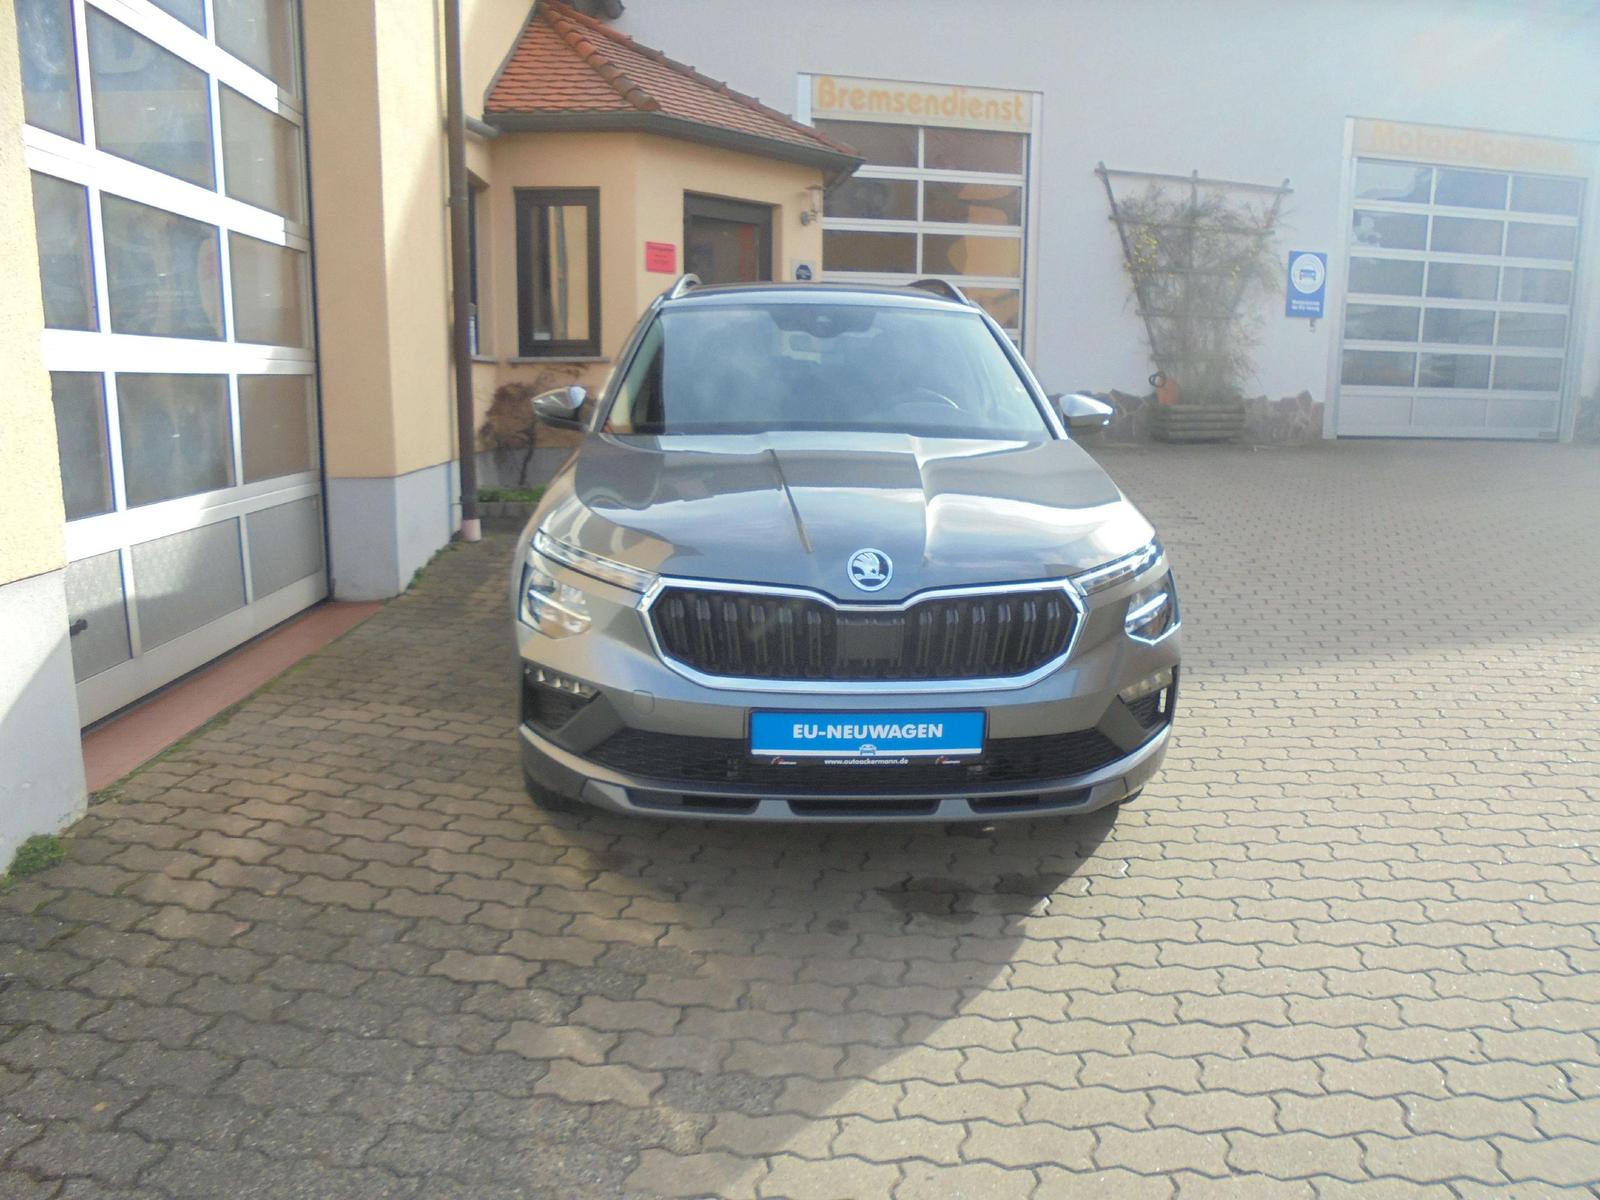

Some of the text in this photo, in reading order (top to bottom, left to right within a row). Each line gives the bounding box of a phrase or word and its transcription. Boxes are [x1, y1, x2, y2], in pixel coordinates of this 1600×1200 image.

[817, 77, 1023, 121] Bremsendienst
[1373, 123, 1575, 163] Motordiag
[793, 723, 943, 740] EU-NEUWAGEN
[824, 757, 909, 766] www.autoackermann.de
